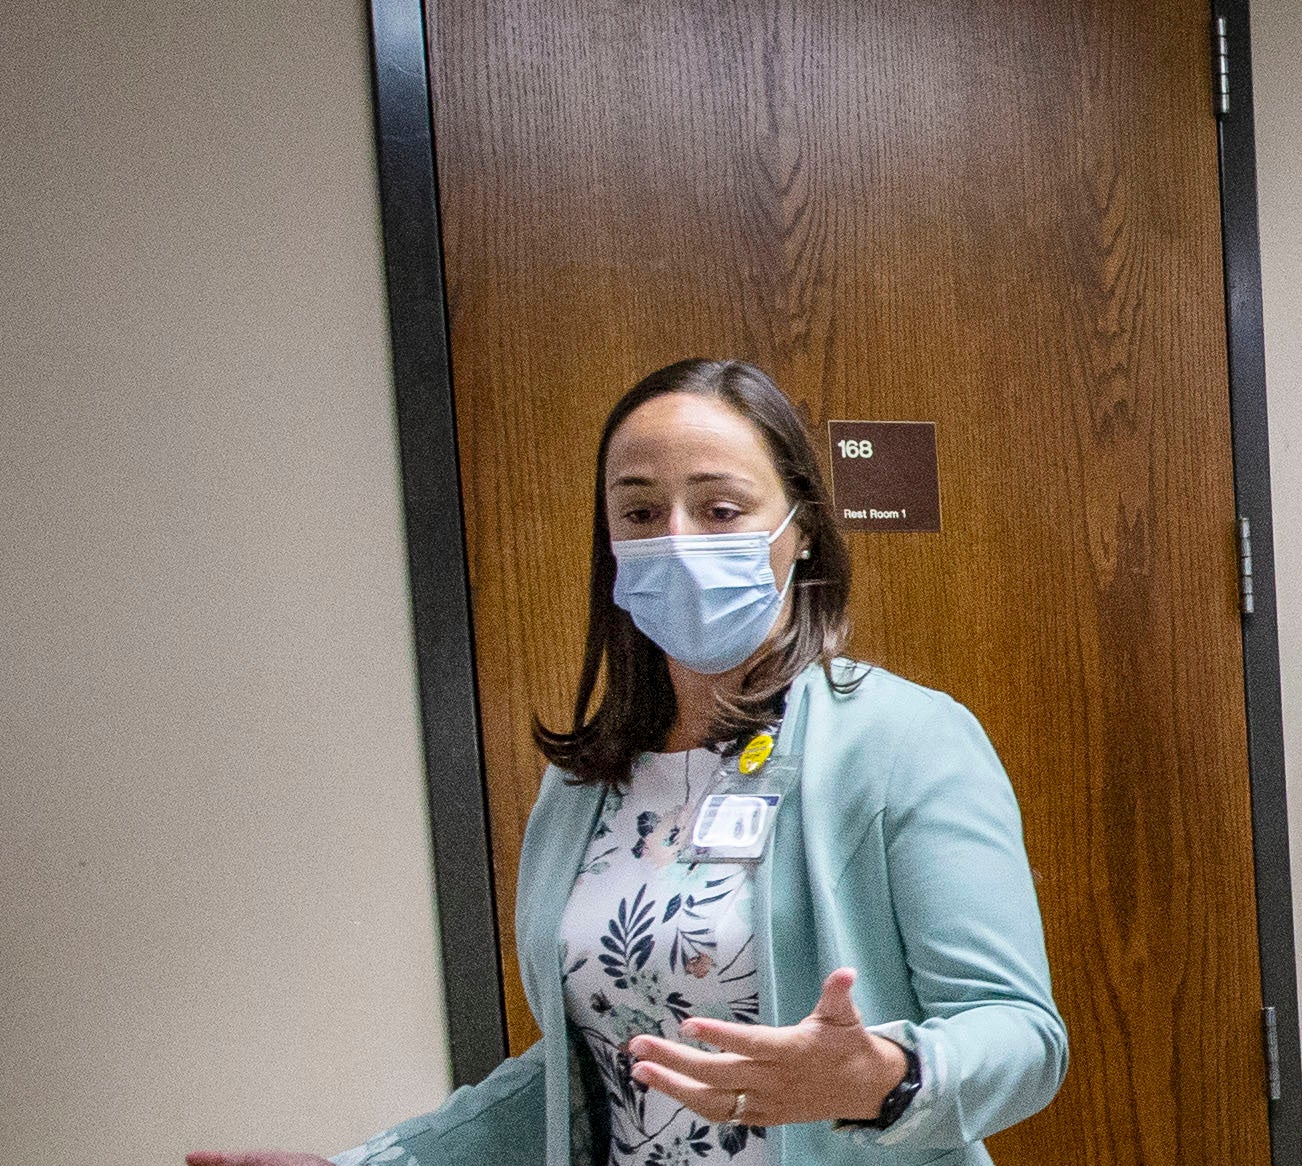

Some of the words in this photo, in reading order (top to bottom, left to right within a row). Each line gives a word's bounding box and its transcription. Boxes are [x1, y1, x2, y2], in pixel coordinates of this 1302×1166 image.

[838, 439, 873, 459] 168
[843, 508, 867, 519] Rest
[870, 508, 899, 519] Room
[901, 508, 907, 519] 1
